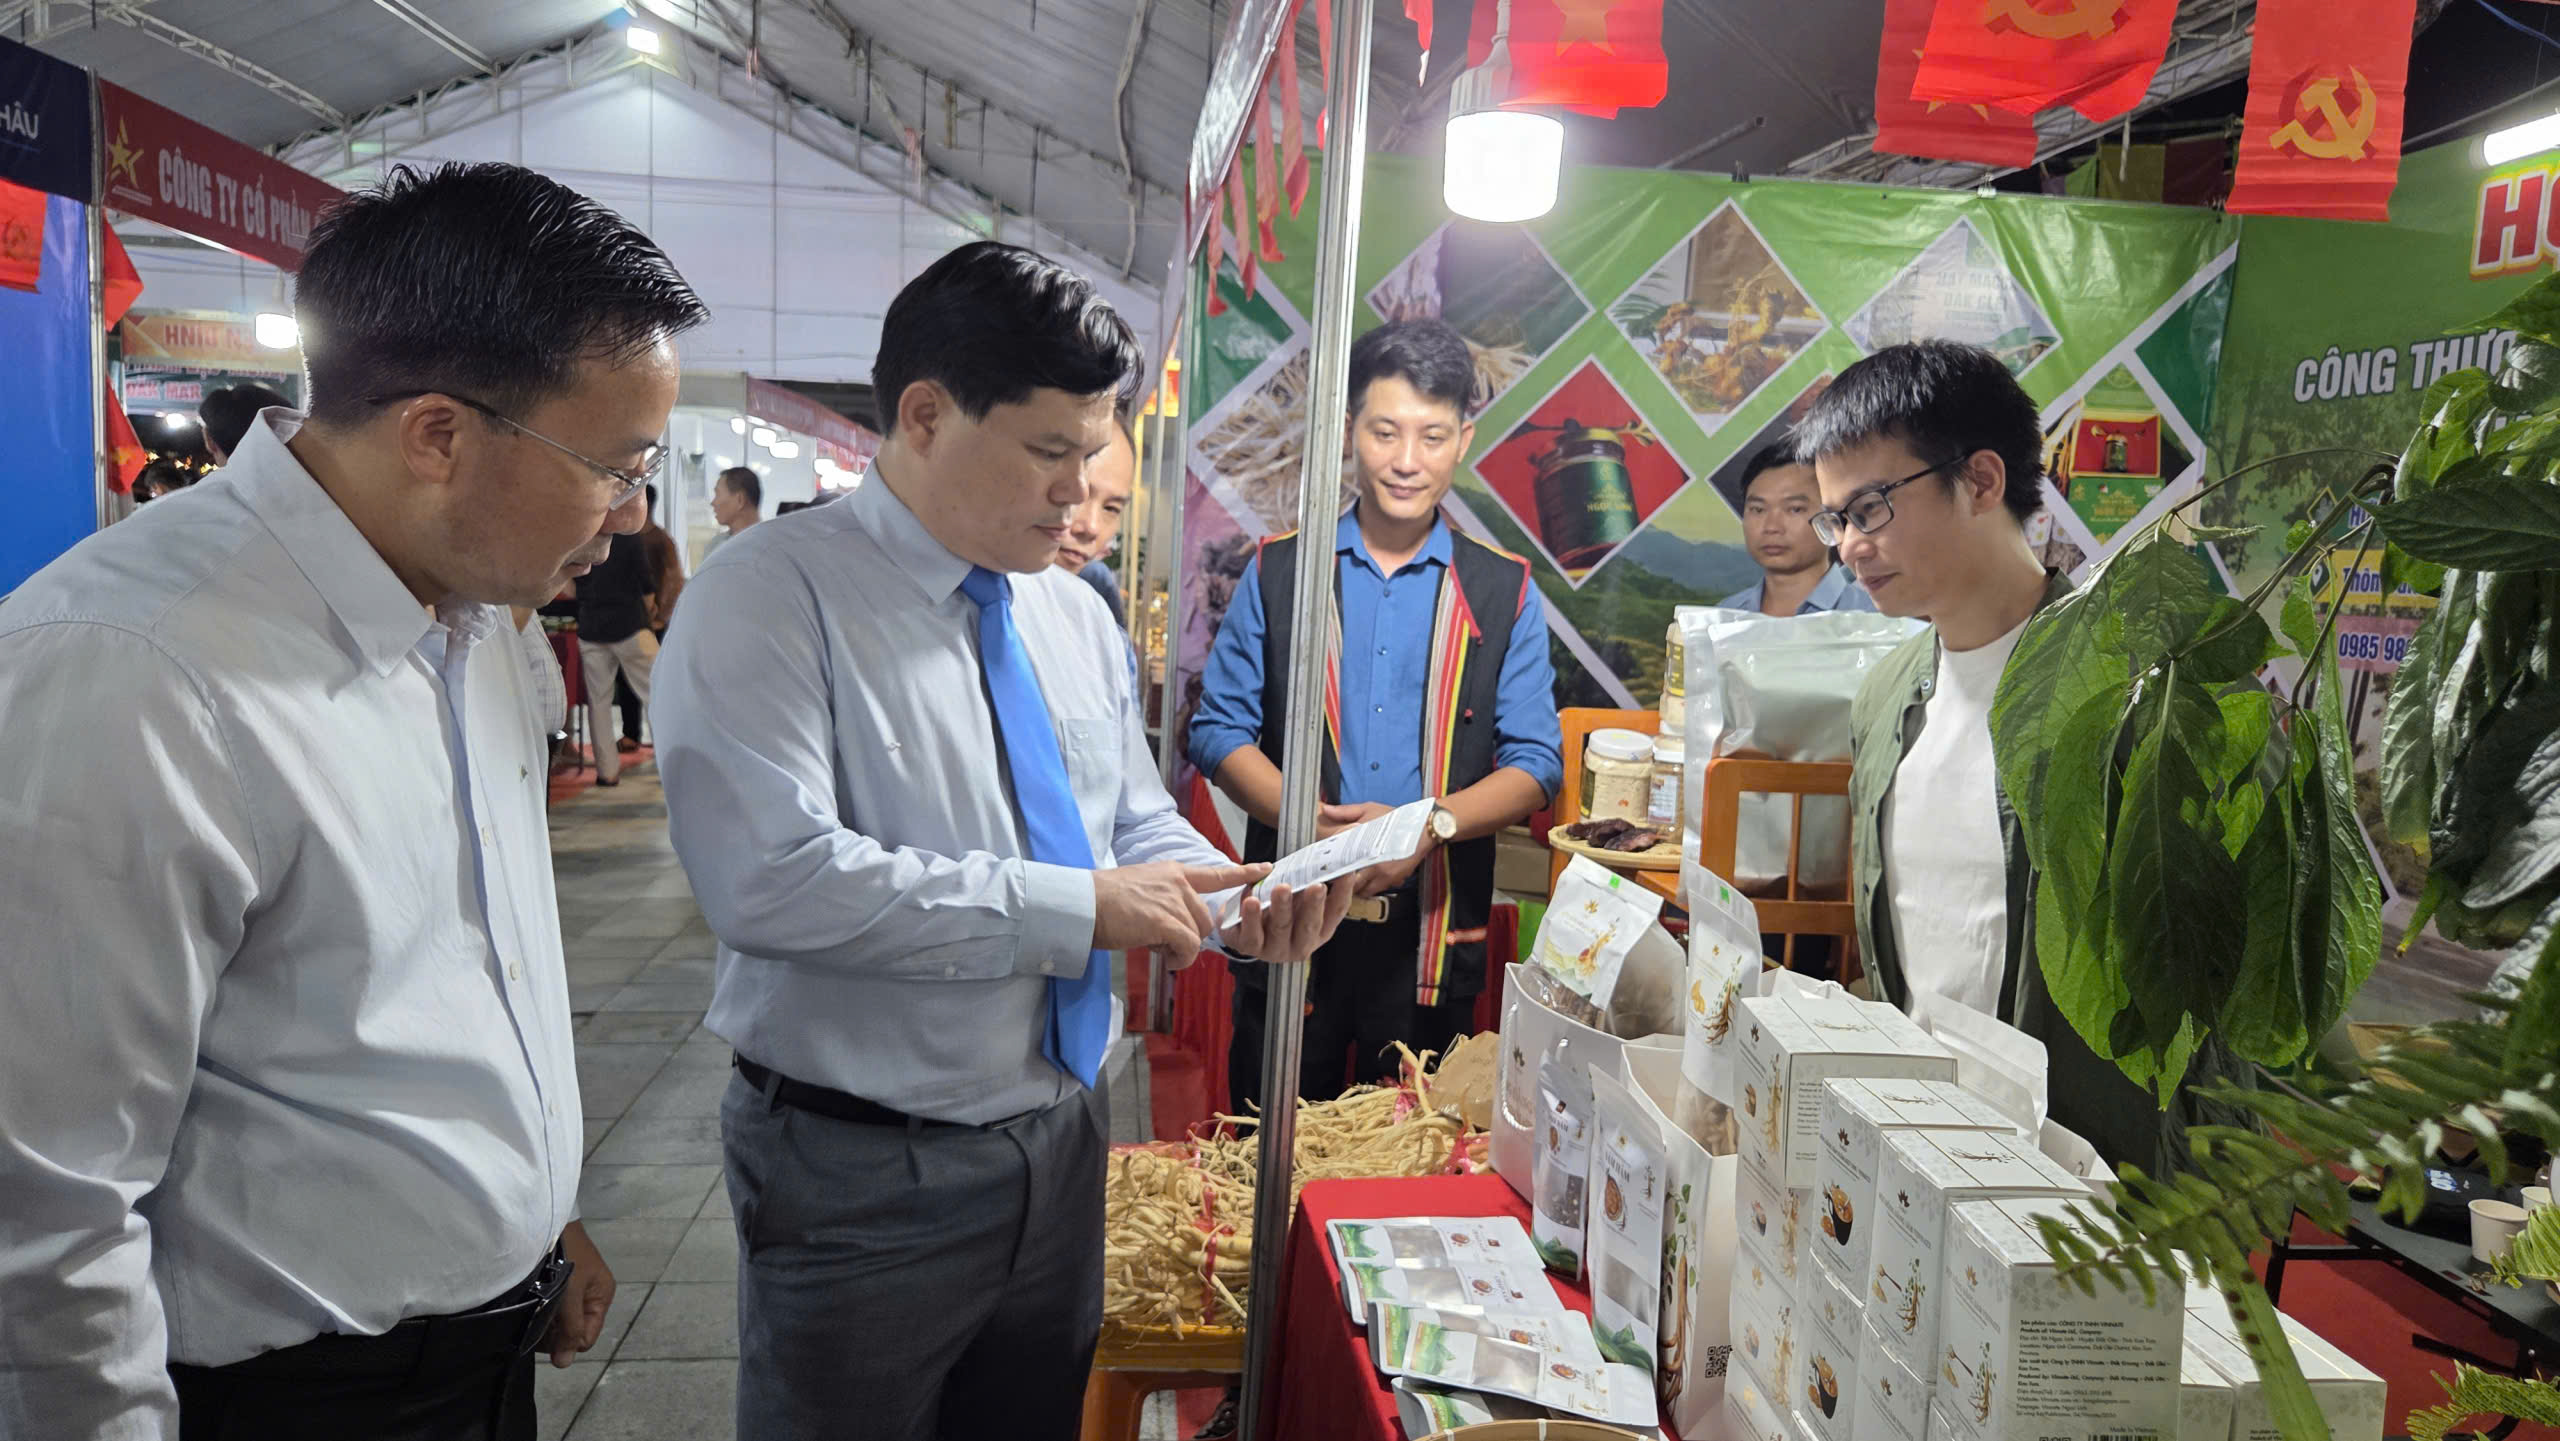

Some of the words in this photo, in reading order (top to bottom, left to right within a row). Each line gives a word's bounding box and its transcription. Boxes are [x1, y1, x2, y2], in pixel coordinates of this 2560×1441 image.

[159, 146, 212, 219] CÔNG
[216, 172, 237, 228] TY
[243, 172, 266, 239] CỔ
[2471, 164, 2560, 281] H
[2293, 345, 2398, 403] CÔNG
[2338, 633, 2380, 660] 0985
[2384, 636, 2412, 663] 98
